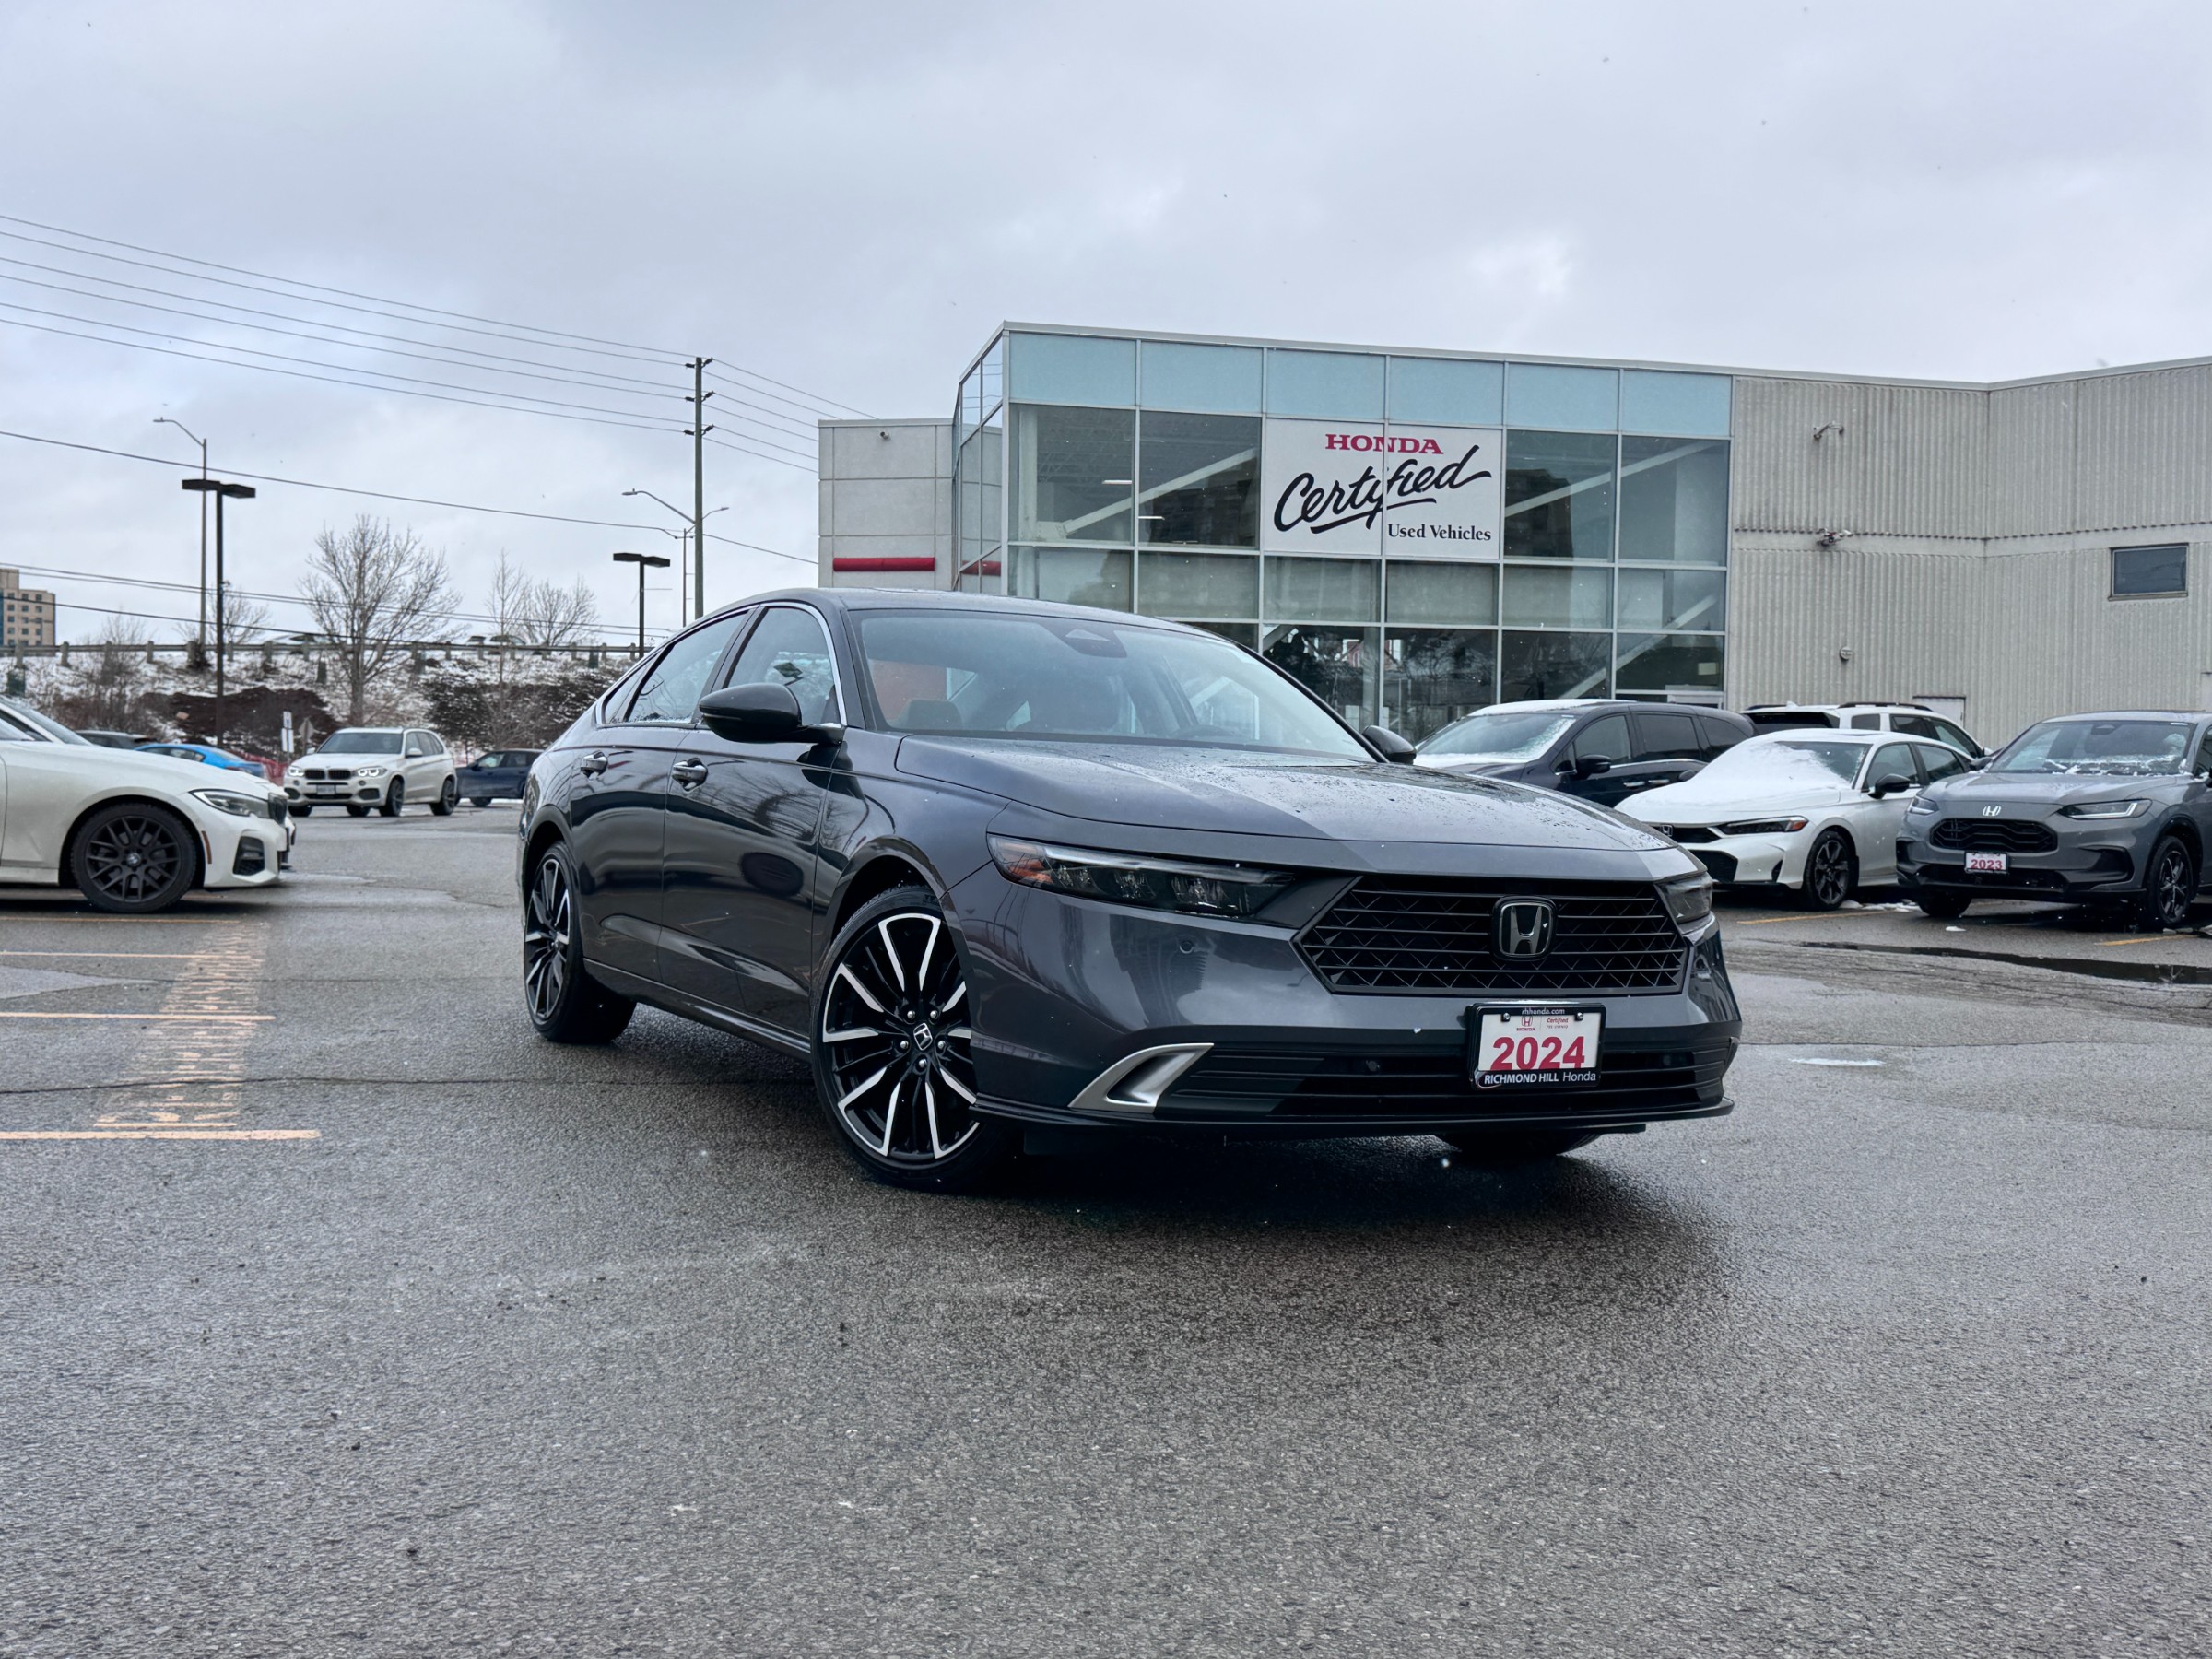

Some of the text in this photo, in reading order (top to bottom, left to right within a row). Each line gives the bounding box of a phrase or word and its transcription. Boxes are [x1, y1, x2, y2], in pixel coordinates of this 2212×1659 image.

[1325, 433, 1444, 454] HONDA
[1274, 444, 1492, 534] Certified
[1387, 524, 1491, 541] Used Vehicles
[1971, 859, 2003, 870] 2023
[1490, 1036, 1585, 1071] 2024
[1484, 1071, 1596, 1084] RICHMOND HILL Honda
